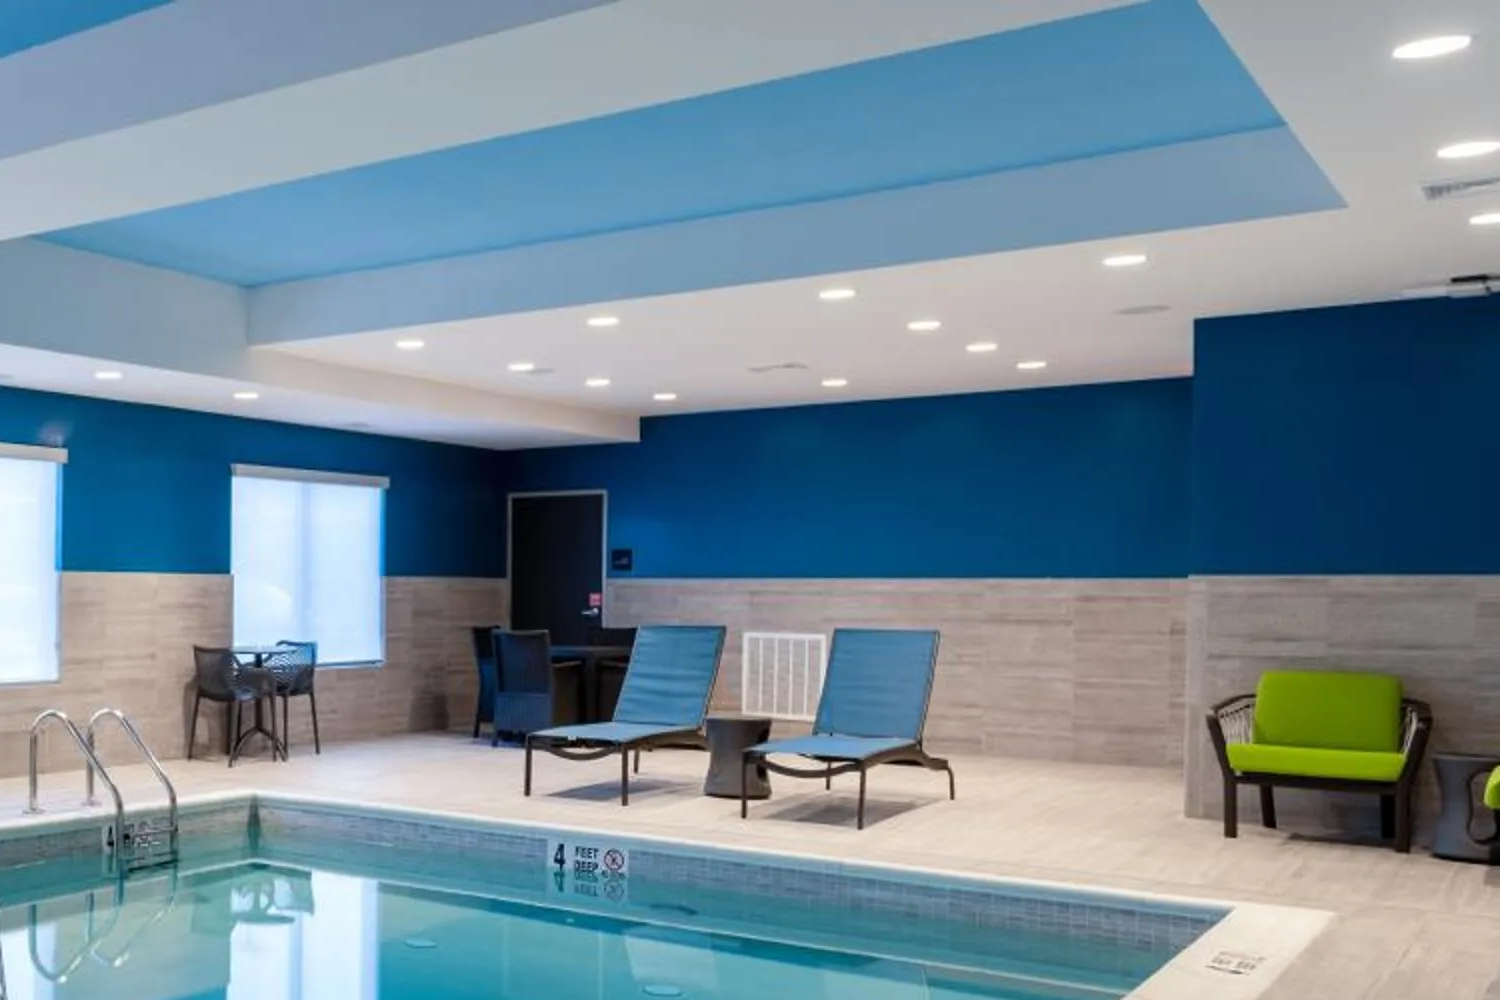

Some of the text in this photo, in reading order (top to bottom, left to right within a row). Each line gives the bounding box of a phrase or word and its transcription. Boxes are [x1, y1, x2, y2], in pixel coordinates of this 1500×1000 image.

[553, 843, 565, 871] 4
[575, 846, 599, 859] FEET
[574, 860, 599, 872] DEEP
